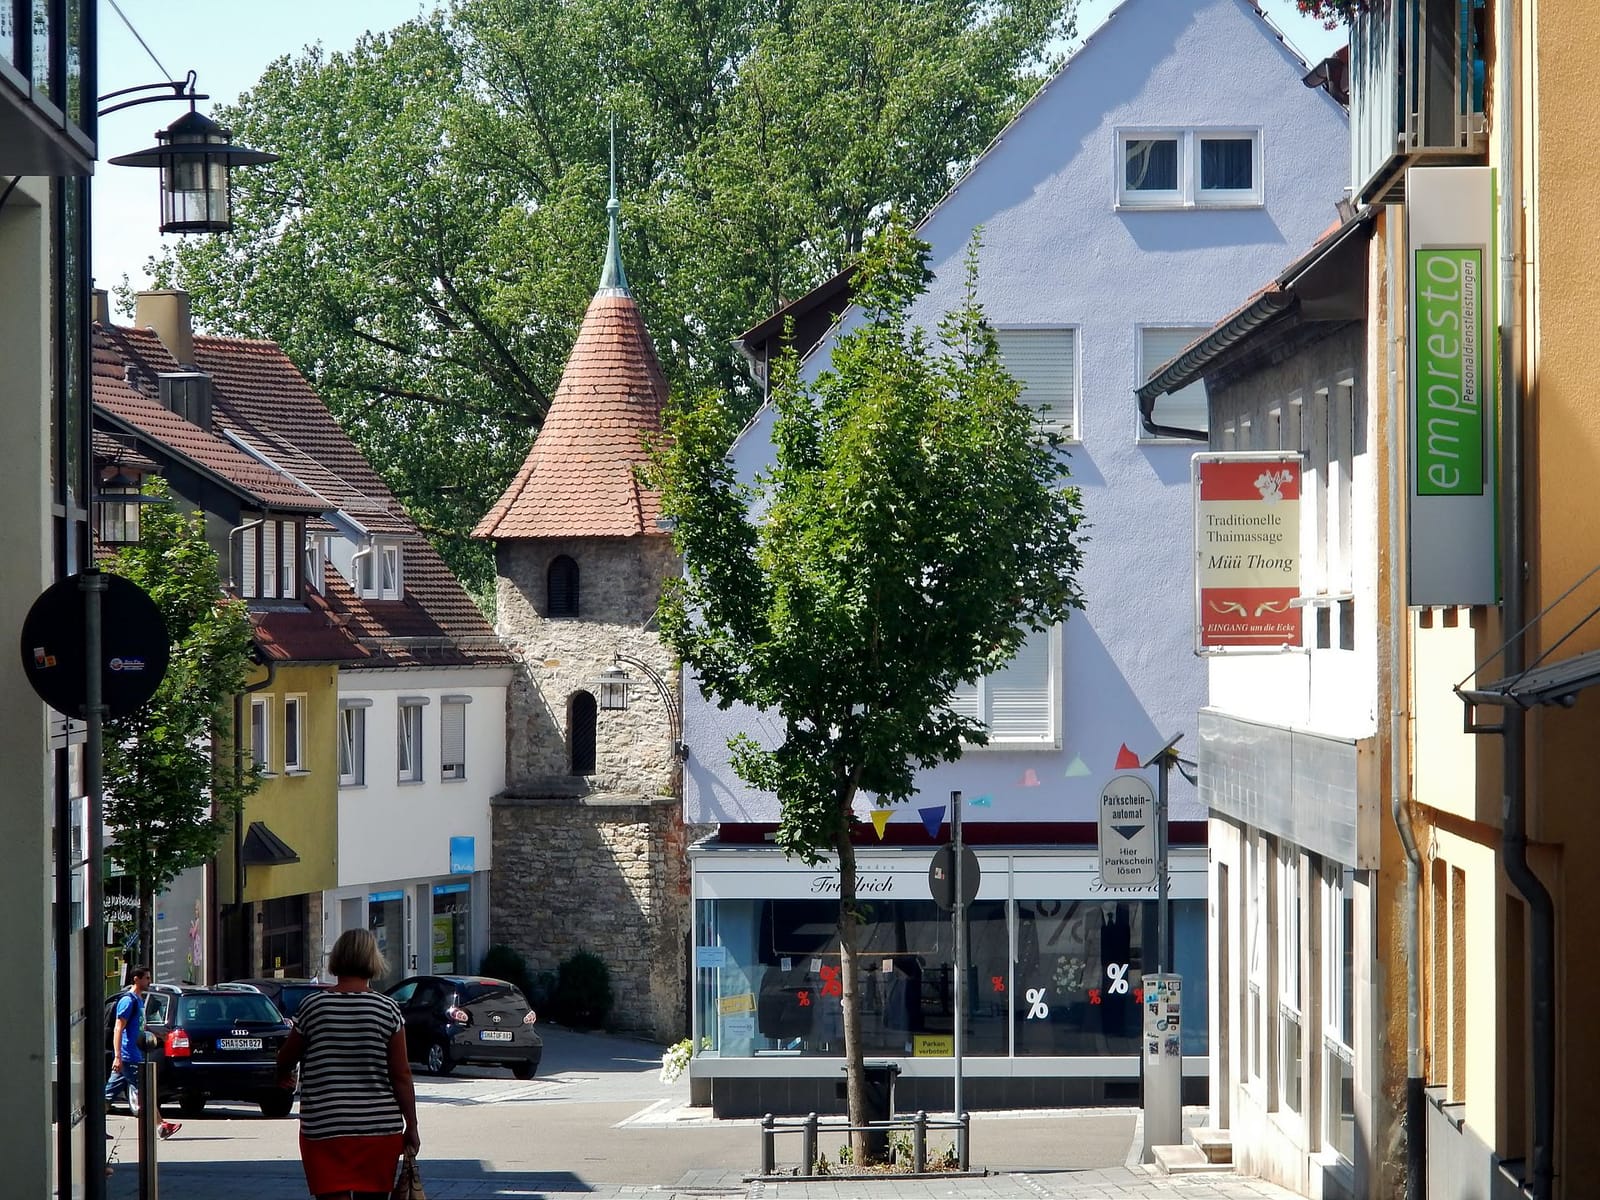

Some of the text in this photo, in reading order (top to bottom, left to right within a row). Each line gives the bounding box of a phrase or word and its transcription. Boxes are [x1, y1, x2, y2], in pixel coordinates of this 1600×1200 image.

[1463, 261, 1476, 402] Personaldienstleistungen
[1421, 256, 1477, 488] empresto
[1206, 514, 1281, 526] Traditionelle
[1206, 530, 1283, 544] Thaimassage
[1208, 554, 1293, 572] Müü Thong
[1207, 623, 1248, 632] EINGANG
[1276, 623, 1295, 631] Ecke
[1103, 794, 1150, 806] Parkschein-
[1112, 809, 1142, 819] automat
[1119, 848, 1138, 856] Hier
[1105, 856, 1153, 866] Parkschein
[1117, 867, 1142, 875] lösen
[1107, 963, 1129, 994] %
[1026, 988, 1048, 1019] %
